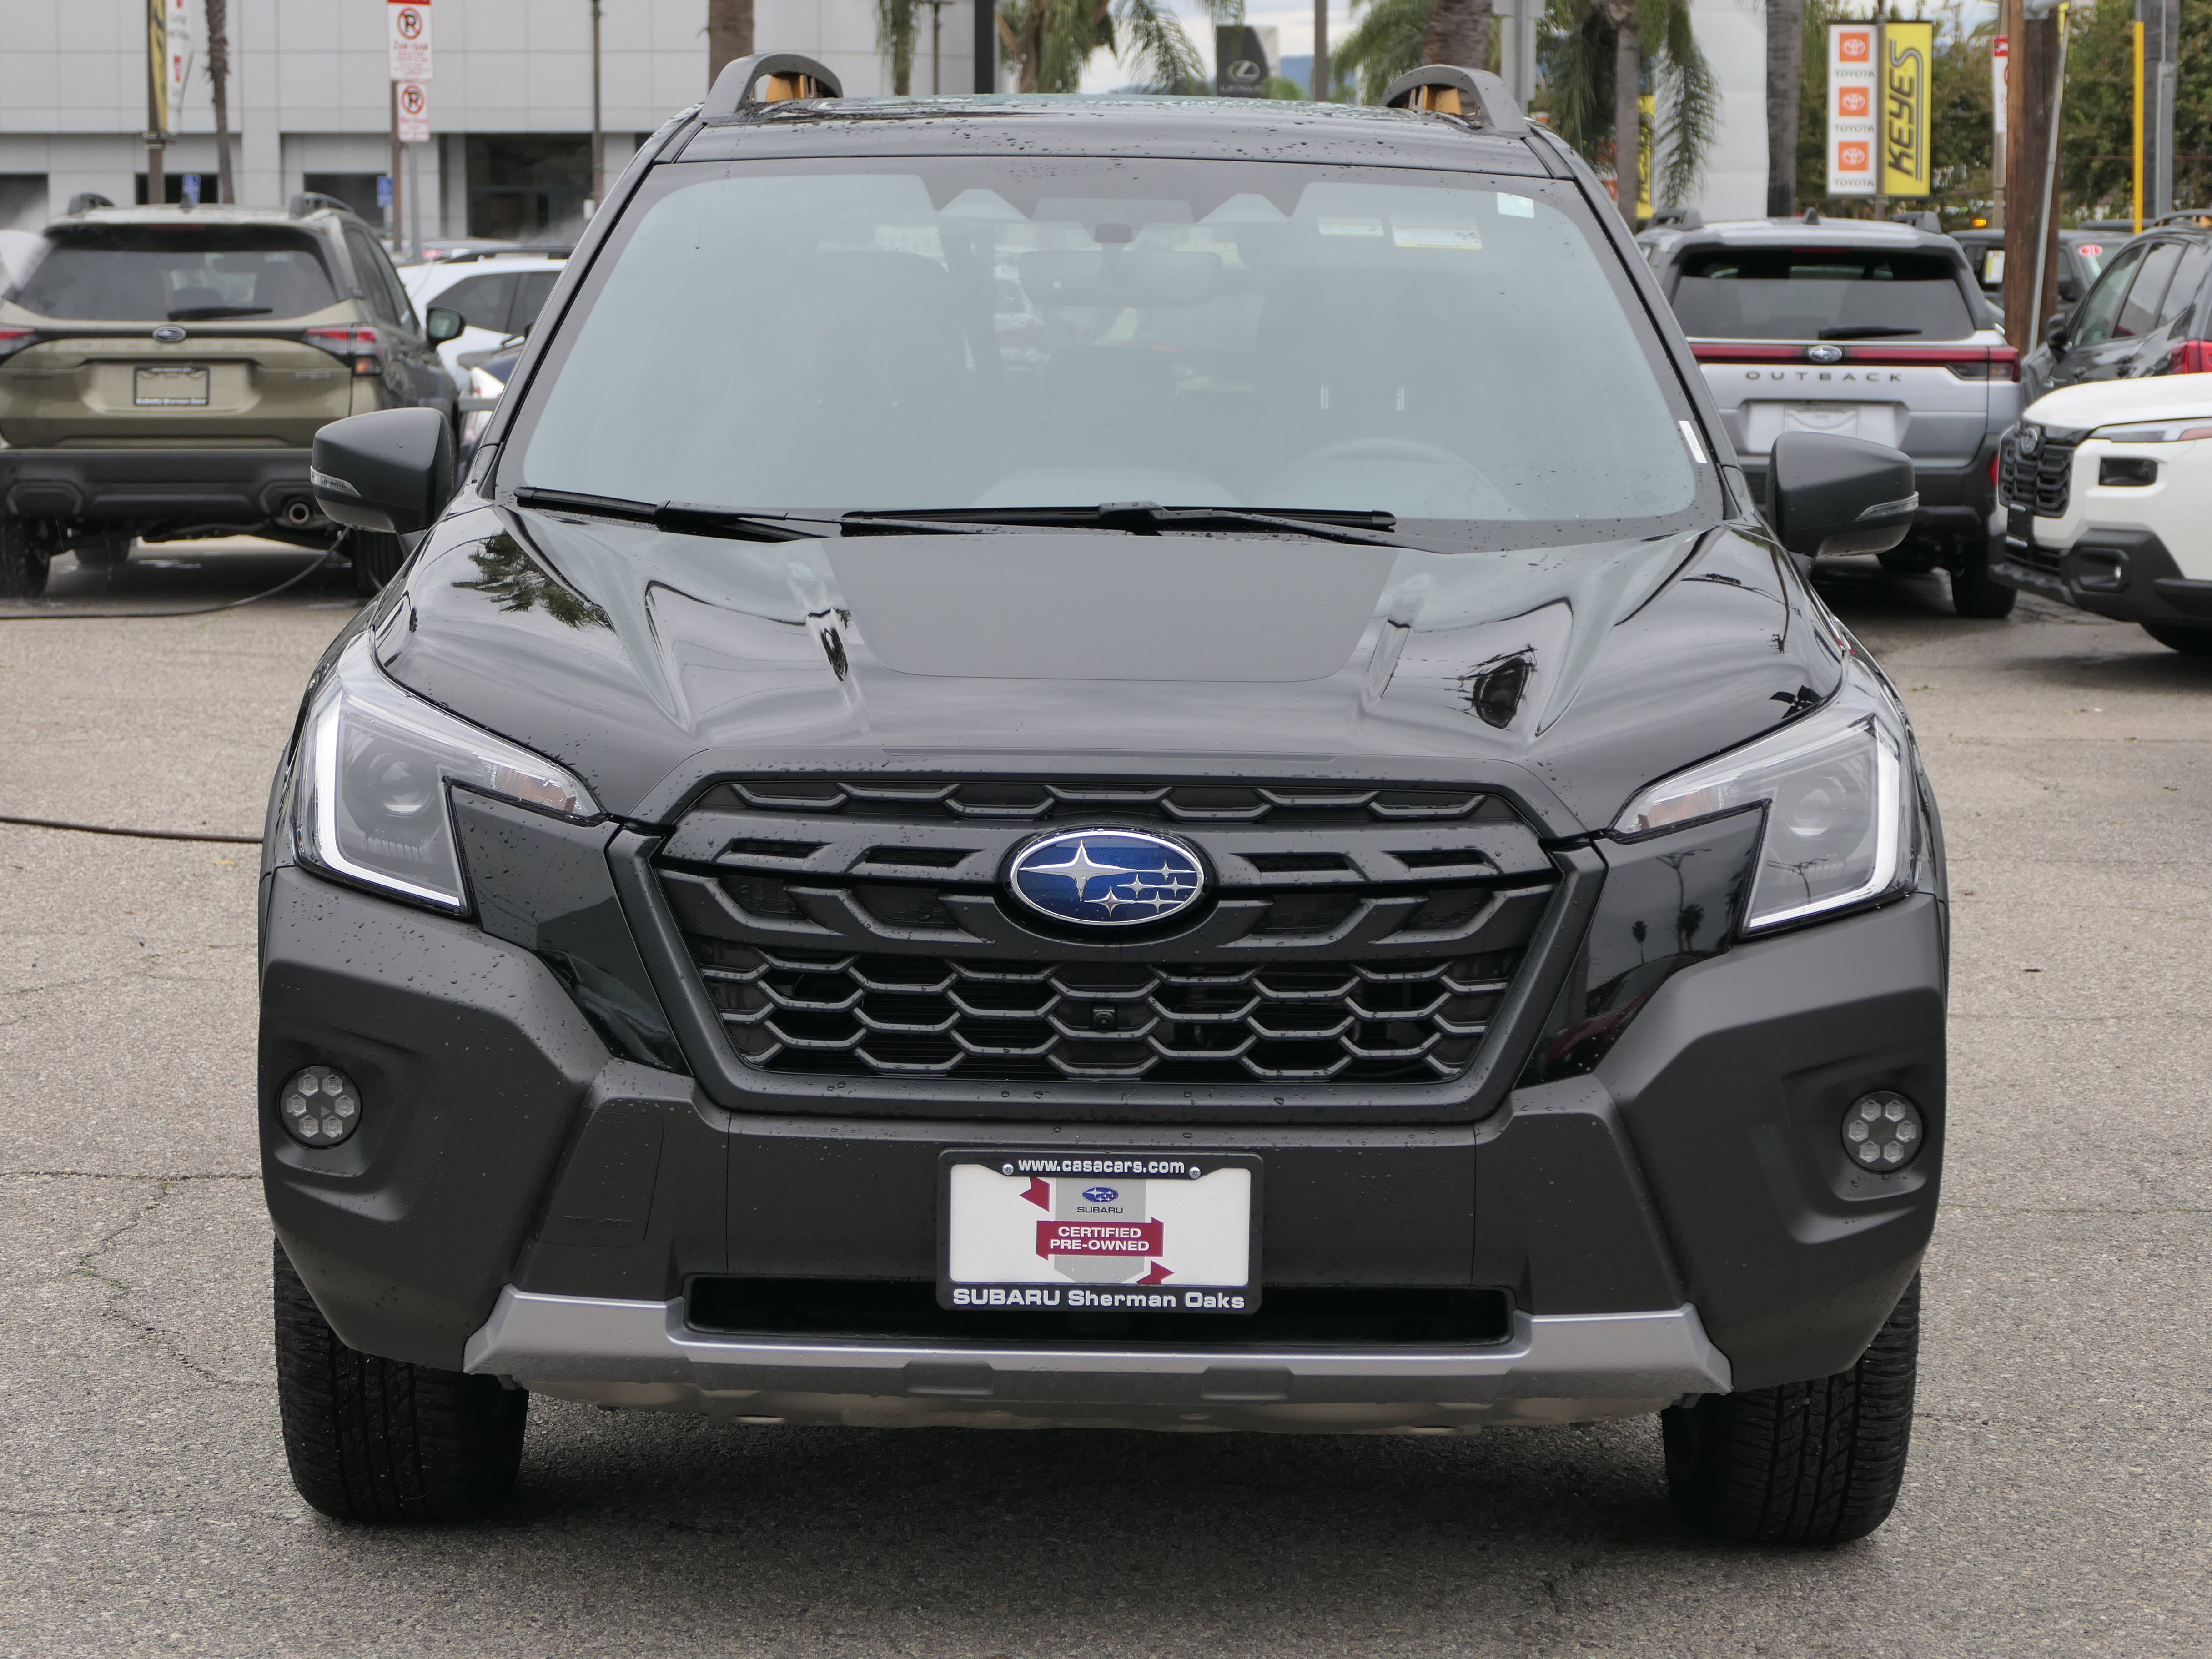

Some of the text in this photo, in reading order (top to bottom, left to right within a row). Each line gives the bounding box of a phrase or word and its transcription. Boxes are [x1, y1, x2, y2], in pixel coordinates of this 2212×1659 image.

[1834, 69, 1875, 78] TOYOTA
[1888, 38, 1924, 181] KEYES
[1834, 124, 1875, 133] TOYOTA
[1834, 178, 1874, 187] TOYOTA
[1745, 371, 1902, 382] OUTBACK
[1018, 1160, 1185, 1173] www.casacars.com
[1058, 1227, 1141, 1238] CERTIFIED
[1050, 1239, 1150, 1251] PRE-OWNED
[954, 1289, 1245, 1308] SUBARU Sherman Oaks
